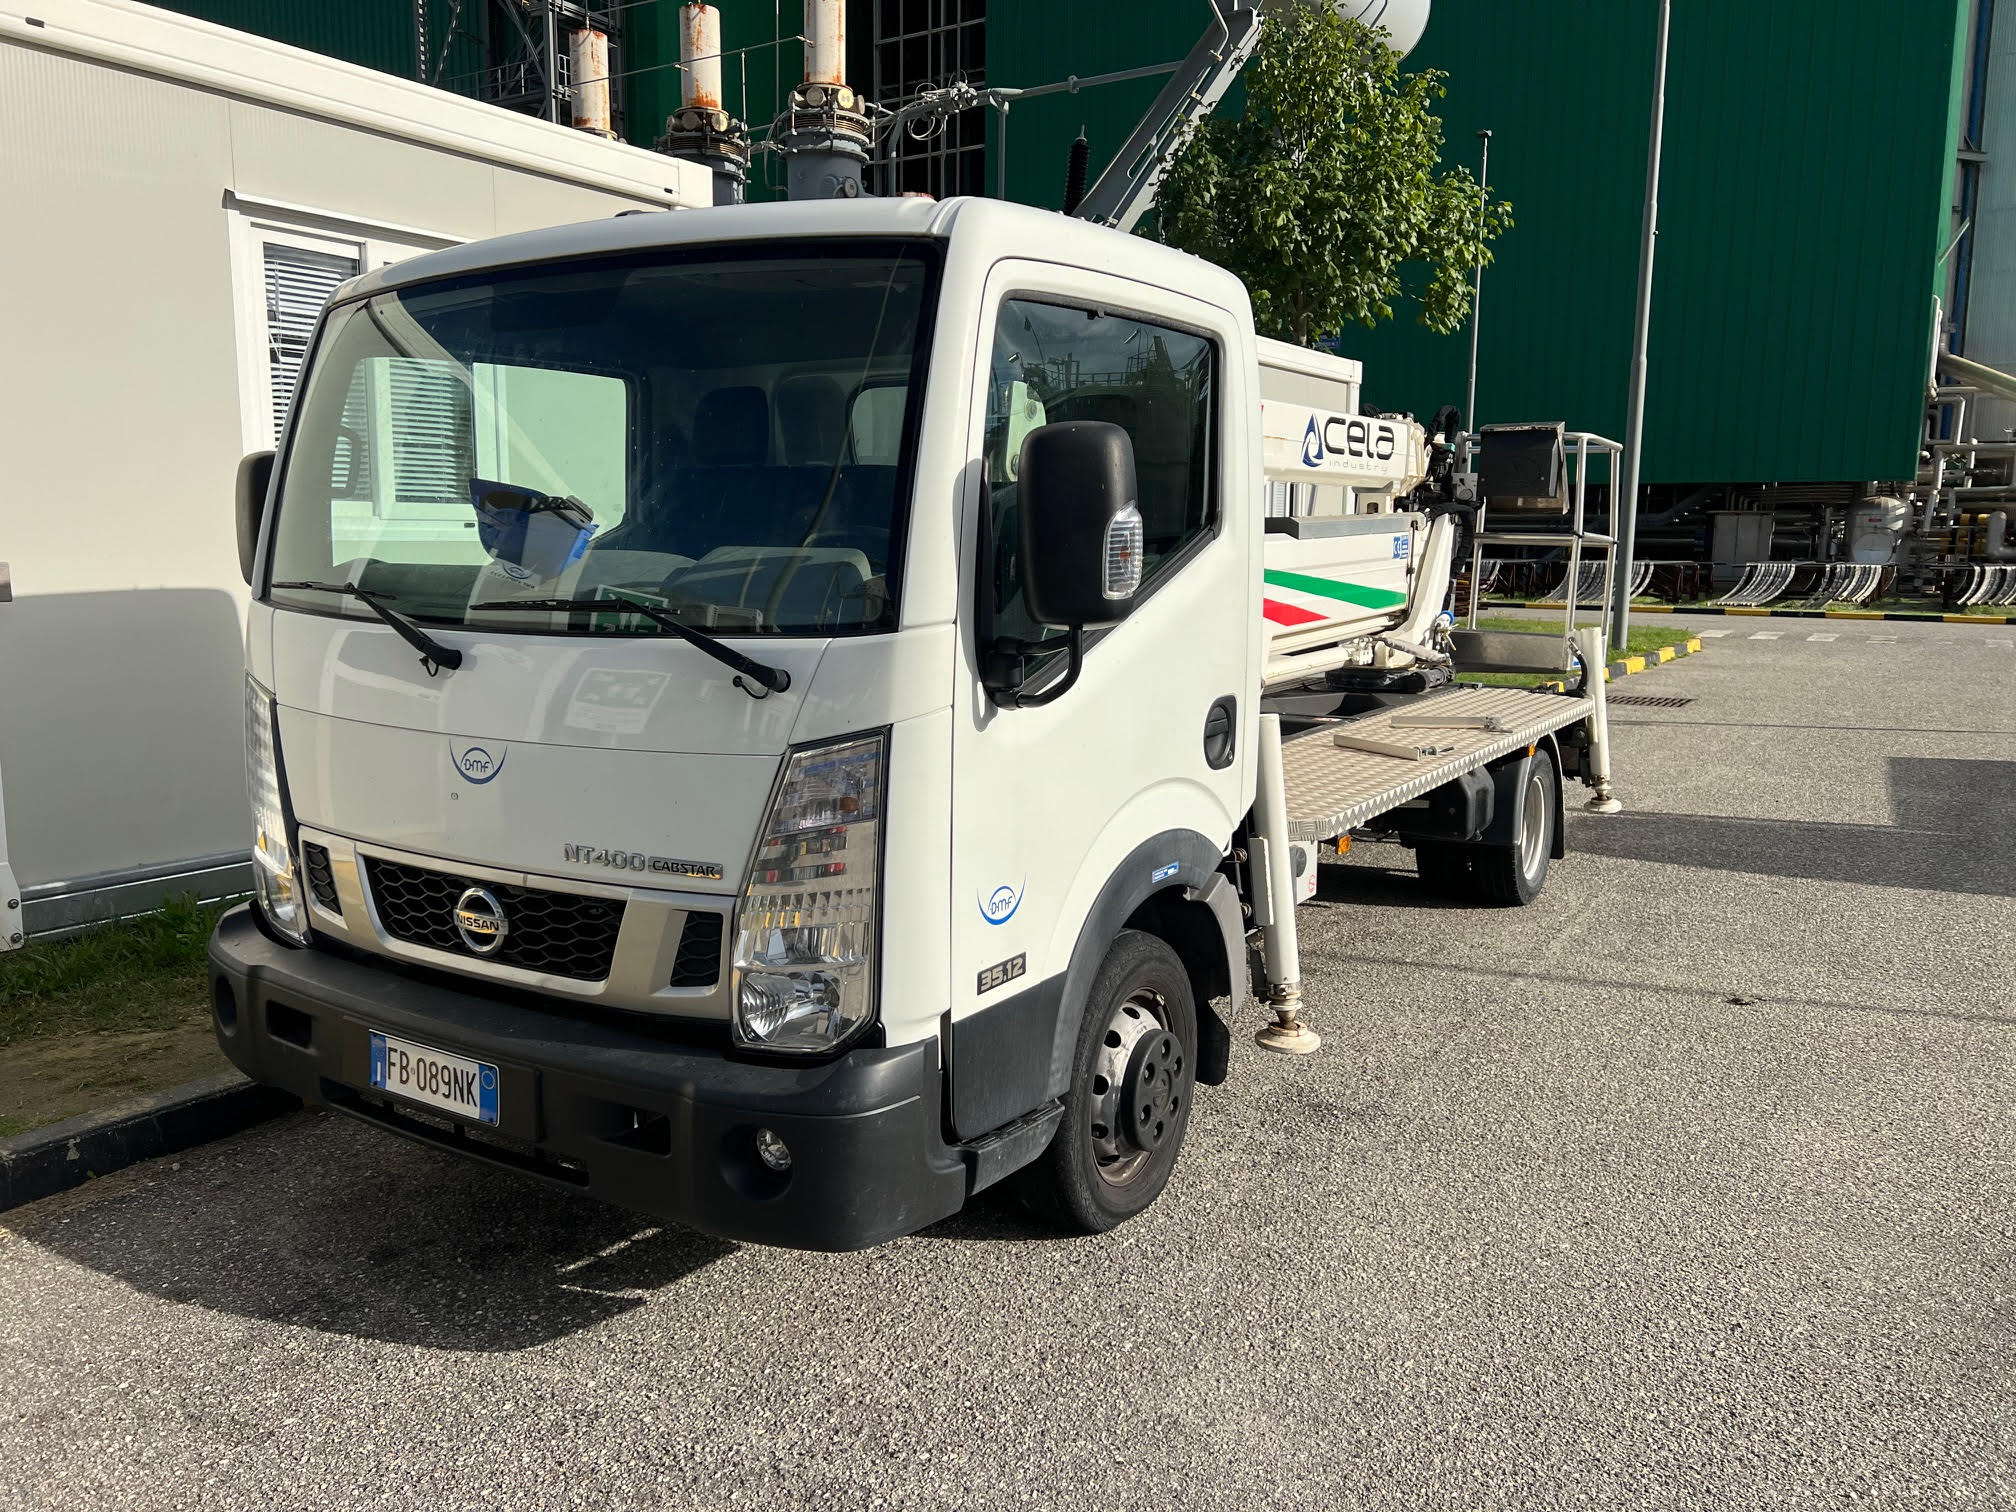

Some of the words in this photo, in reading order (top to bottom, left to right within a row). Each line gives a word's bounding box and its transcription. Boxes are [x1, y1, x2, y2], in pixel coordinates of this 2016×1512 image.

[1329, 460, 1388, 475] industry
[563, 843, 646, 872] NT400
[652, 860, 716, 878] CABSTAR
[456, 913, 500, 931] NISSAN
[980, 957, 1024, 991] 35.12
